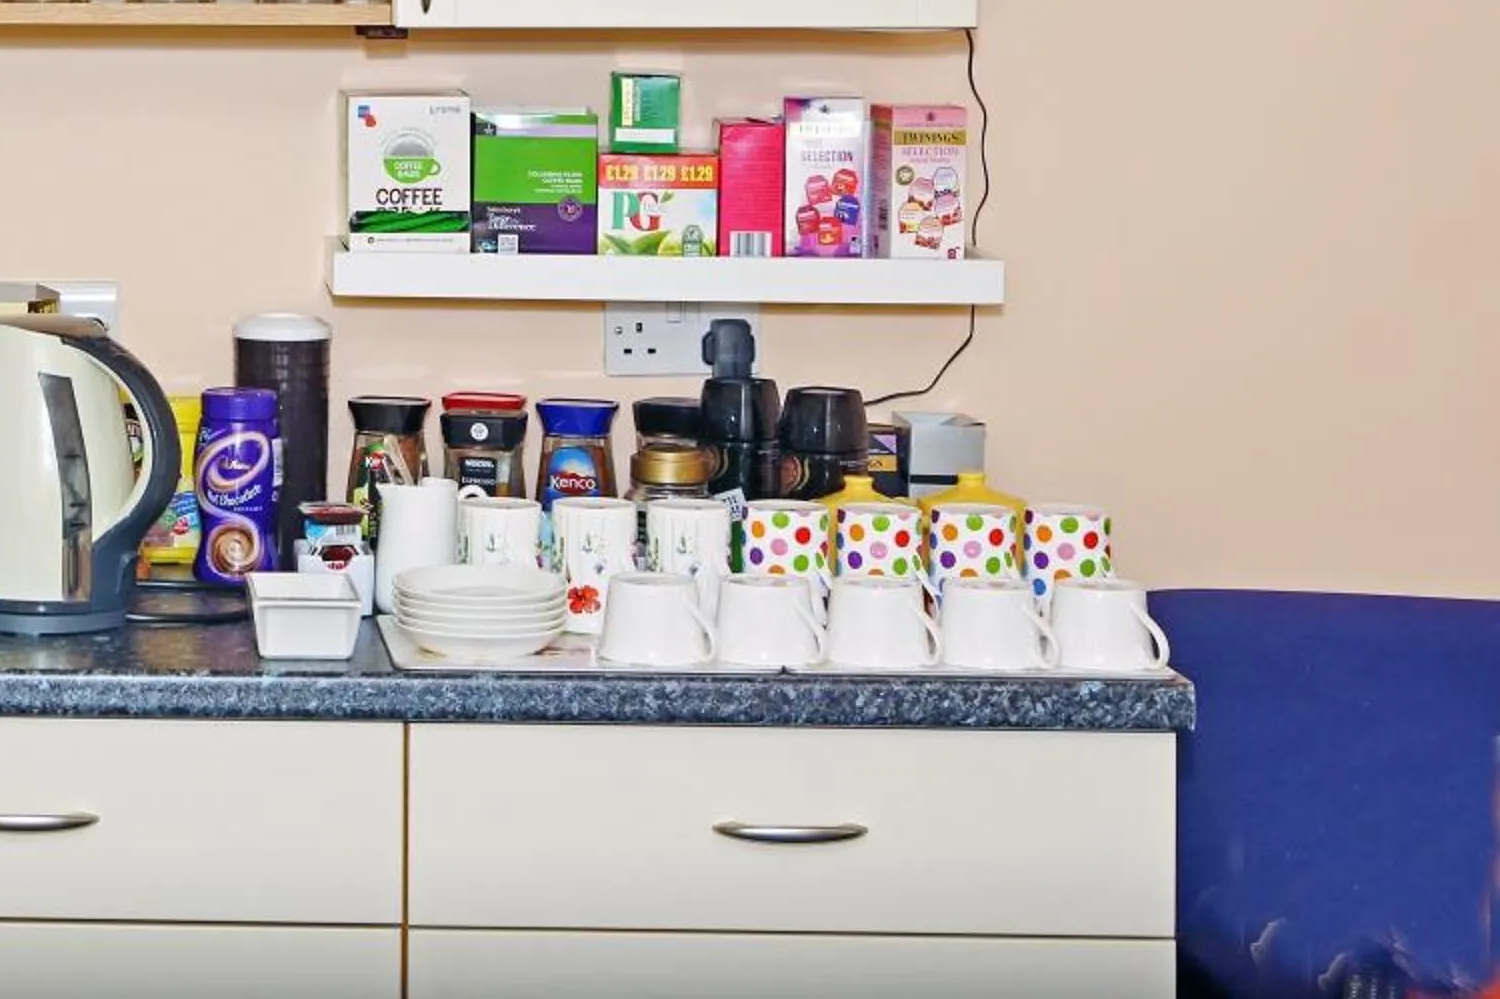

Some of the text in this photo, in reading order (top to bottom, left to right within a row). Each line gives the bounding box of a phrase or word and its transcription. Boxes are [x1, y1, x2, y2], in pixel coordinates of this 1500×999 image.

[902, 131, 960, 142] TWININGS
[801, 150, 853, 162] SELECTION
[606, 164, 714, 182] £1.29 £1.29 £1.29
[375, 188, 443, 206] COFFEE
[611, 191, 662, 232] PG
[549, 474, 597, 490] Kenco
